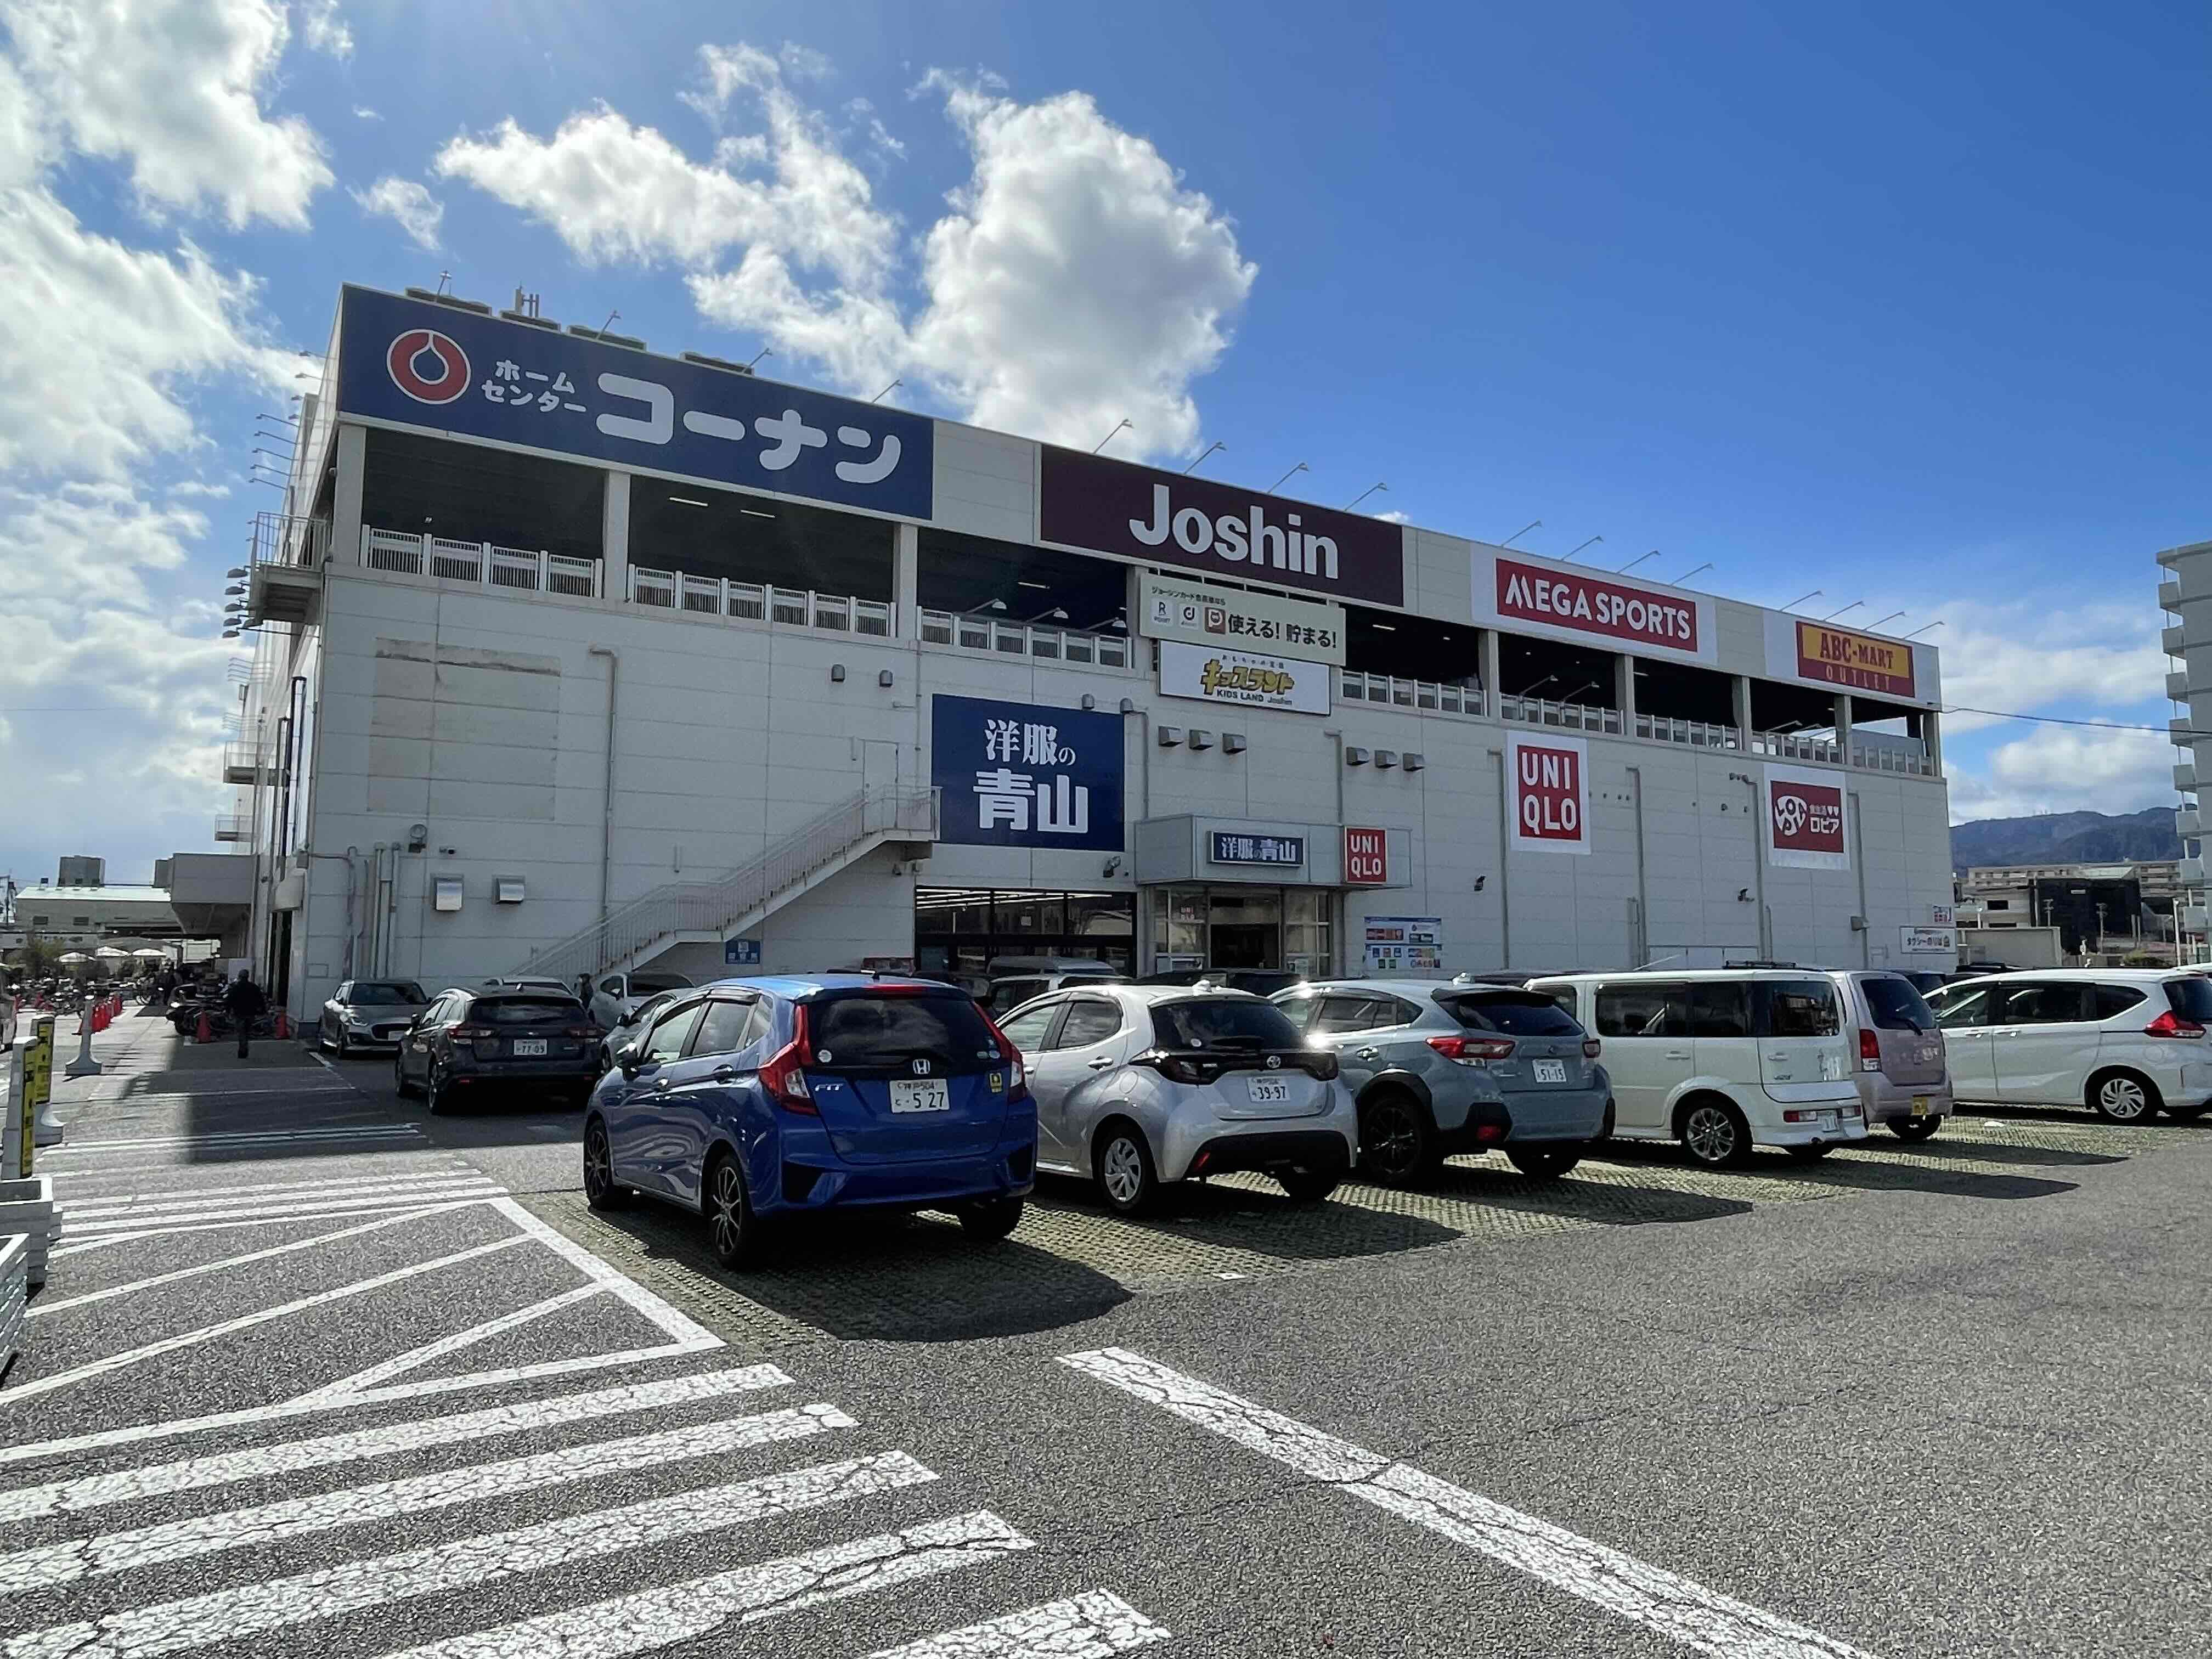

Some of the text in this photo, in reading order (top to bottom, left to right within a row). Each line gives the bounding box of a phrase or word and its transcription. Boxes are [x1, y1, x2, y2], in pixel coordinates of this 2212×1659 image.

[495, 360, 575, 394] ホーム
[481, 380, 587, 412] センター
[596, 373, 901, 484] コーナン
[1128, 484, 1339, 579] Joshin
[1505, 573, 1691, 640] MEGA SPORTS
[1820, 633, 1893, 669] ABC-MART
[1217, 690, 1238, 699] KIDS
[1240, 692, 1264, 702] LAND
[985, 719, 1076, 766] 洋服の
[1522, 752, 1571, 790] UNI
[973, 768, 1088, 833] 青山
[1523, 794, 1577, 835] QLO
[1810, 817, 1840, 834] ロピア
[1221, 836, 1296, 861] 洋服の青山
[1350, 834, 1379, 854] UNI
[1351, 856, 1382, 878] QLO
